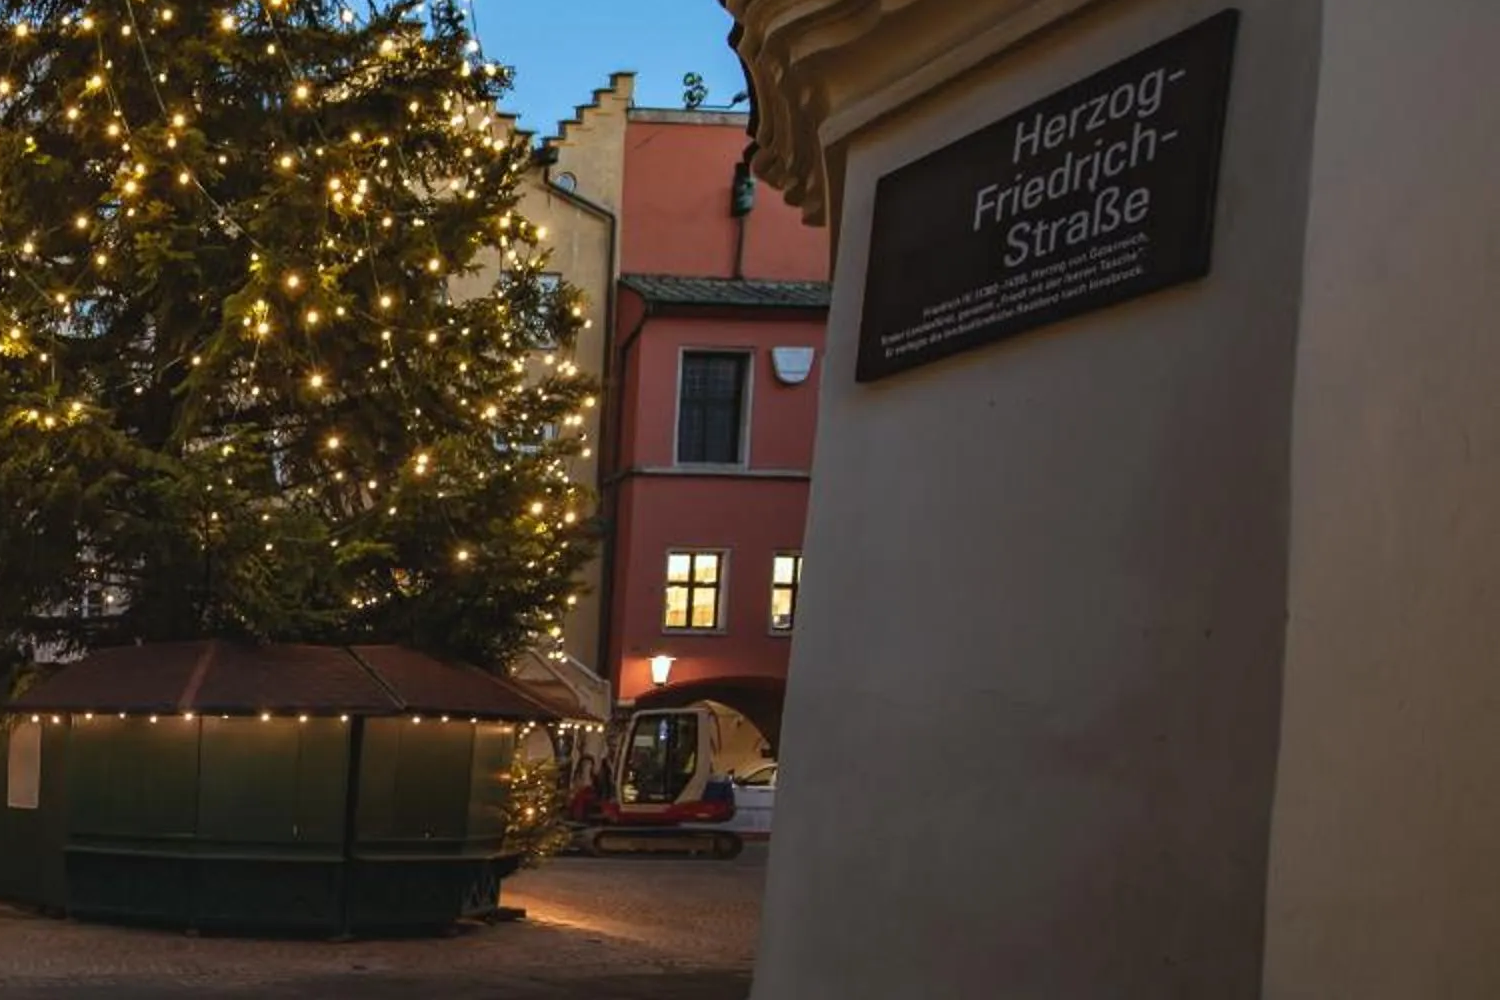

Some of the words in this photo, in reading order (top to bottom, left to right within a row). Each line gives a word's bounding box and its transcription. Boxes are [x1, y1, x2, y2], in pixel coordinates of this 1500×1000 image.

[1013, 67, 1187, 164] Herzog-
[973, 121, 1179, 232] Friedrich-
[1003, 186, 1150, 268] Straße
